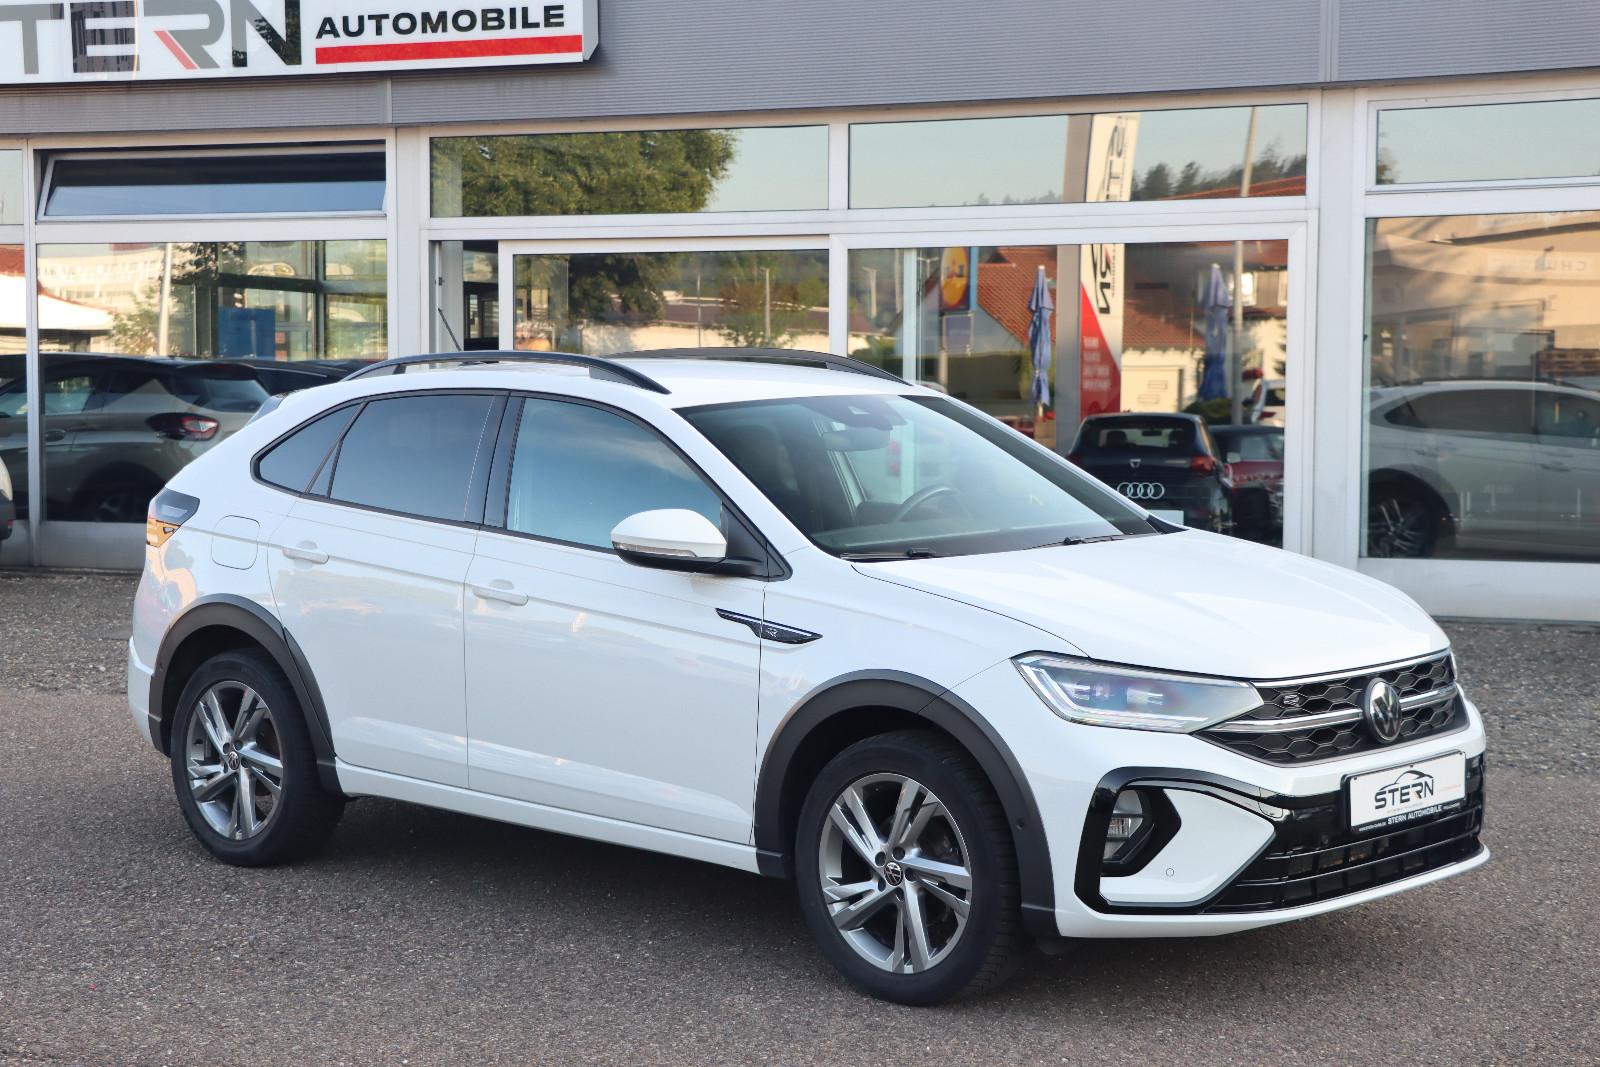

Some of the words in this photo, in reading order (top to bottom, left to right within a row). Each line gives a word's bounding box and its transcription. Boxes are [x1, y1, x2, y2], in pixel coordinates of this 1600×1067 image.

[315, 5, 565, 39] AUTOMOBILE
[1374, 778, 1434, 810] STERN
[1387, 813, 1407, 825] STERN
[1407, 804, 1442, 819] AUTOMOBILE
